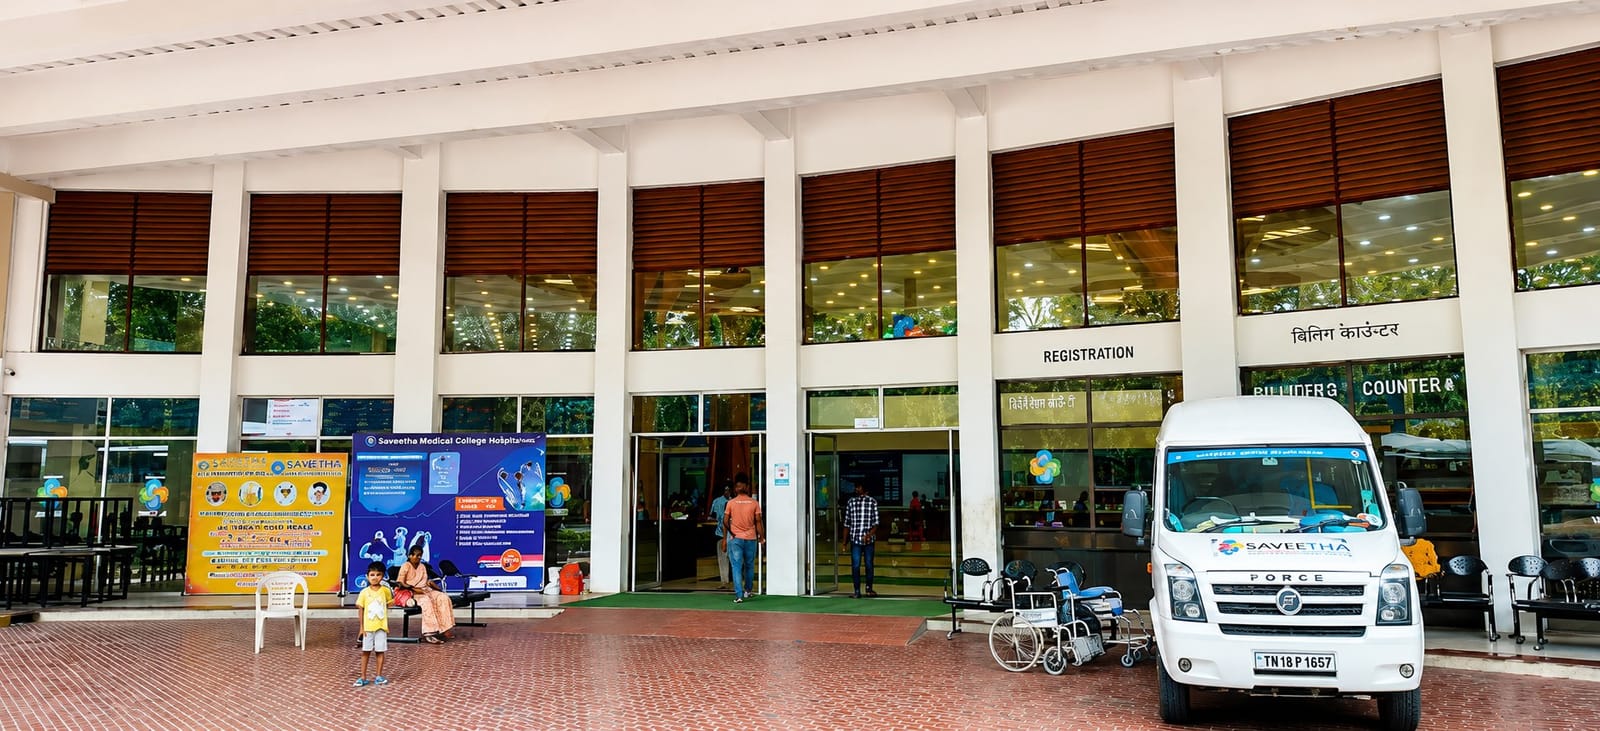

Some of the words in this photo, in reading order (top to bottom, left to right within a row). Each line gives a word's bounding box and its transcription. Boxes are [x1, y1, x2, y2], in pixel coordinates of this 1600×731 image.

[1043, 346, 1134, 363] REGISTRATION
[1362, 377, 1441, 396] COUNTER
[455, 437, 487, 446] College
[1246, 542, 1350, 552] SAVEETHA
